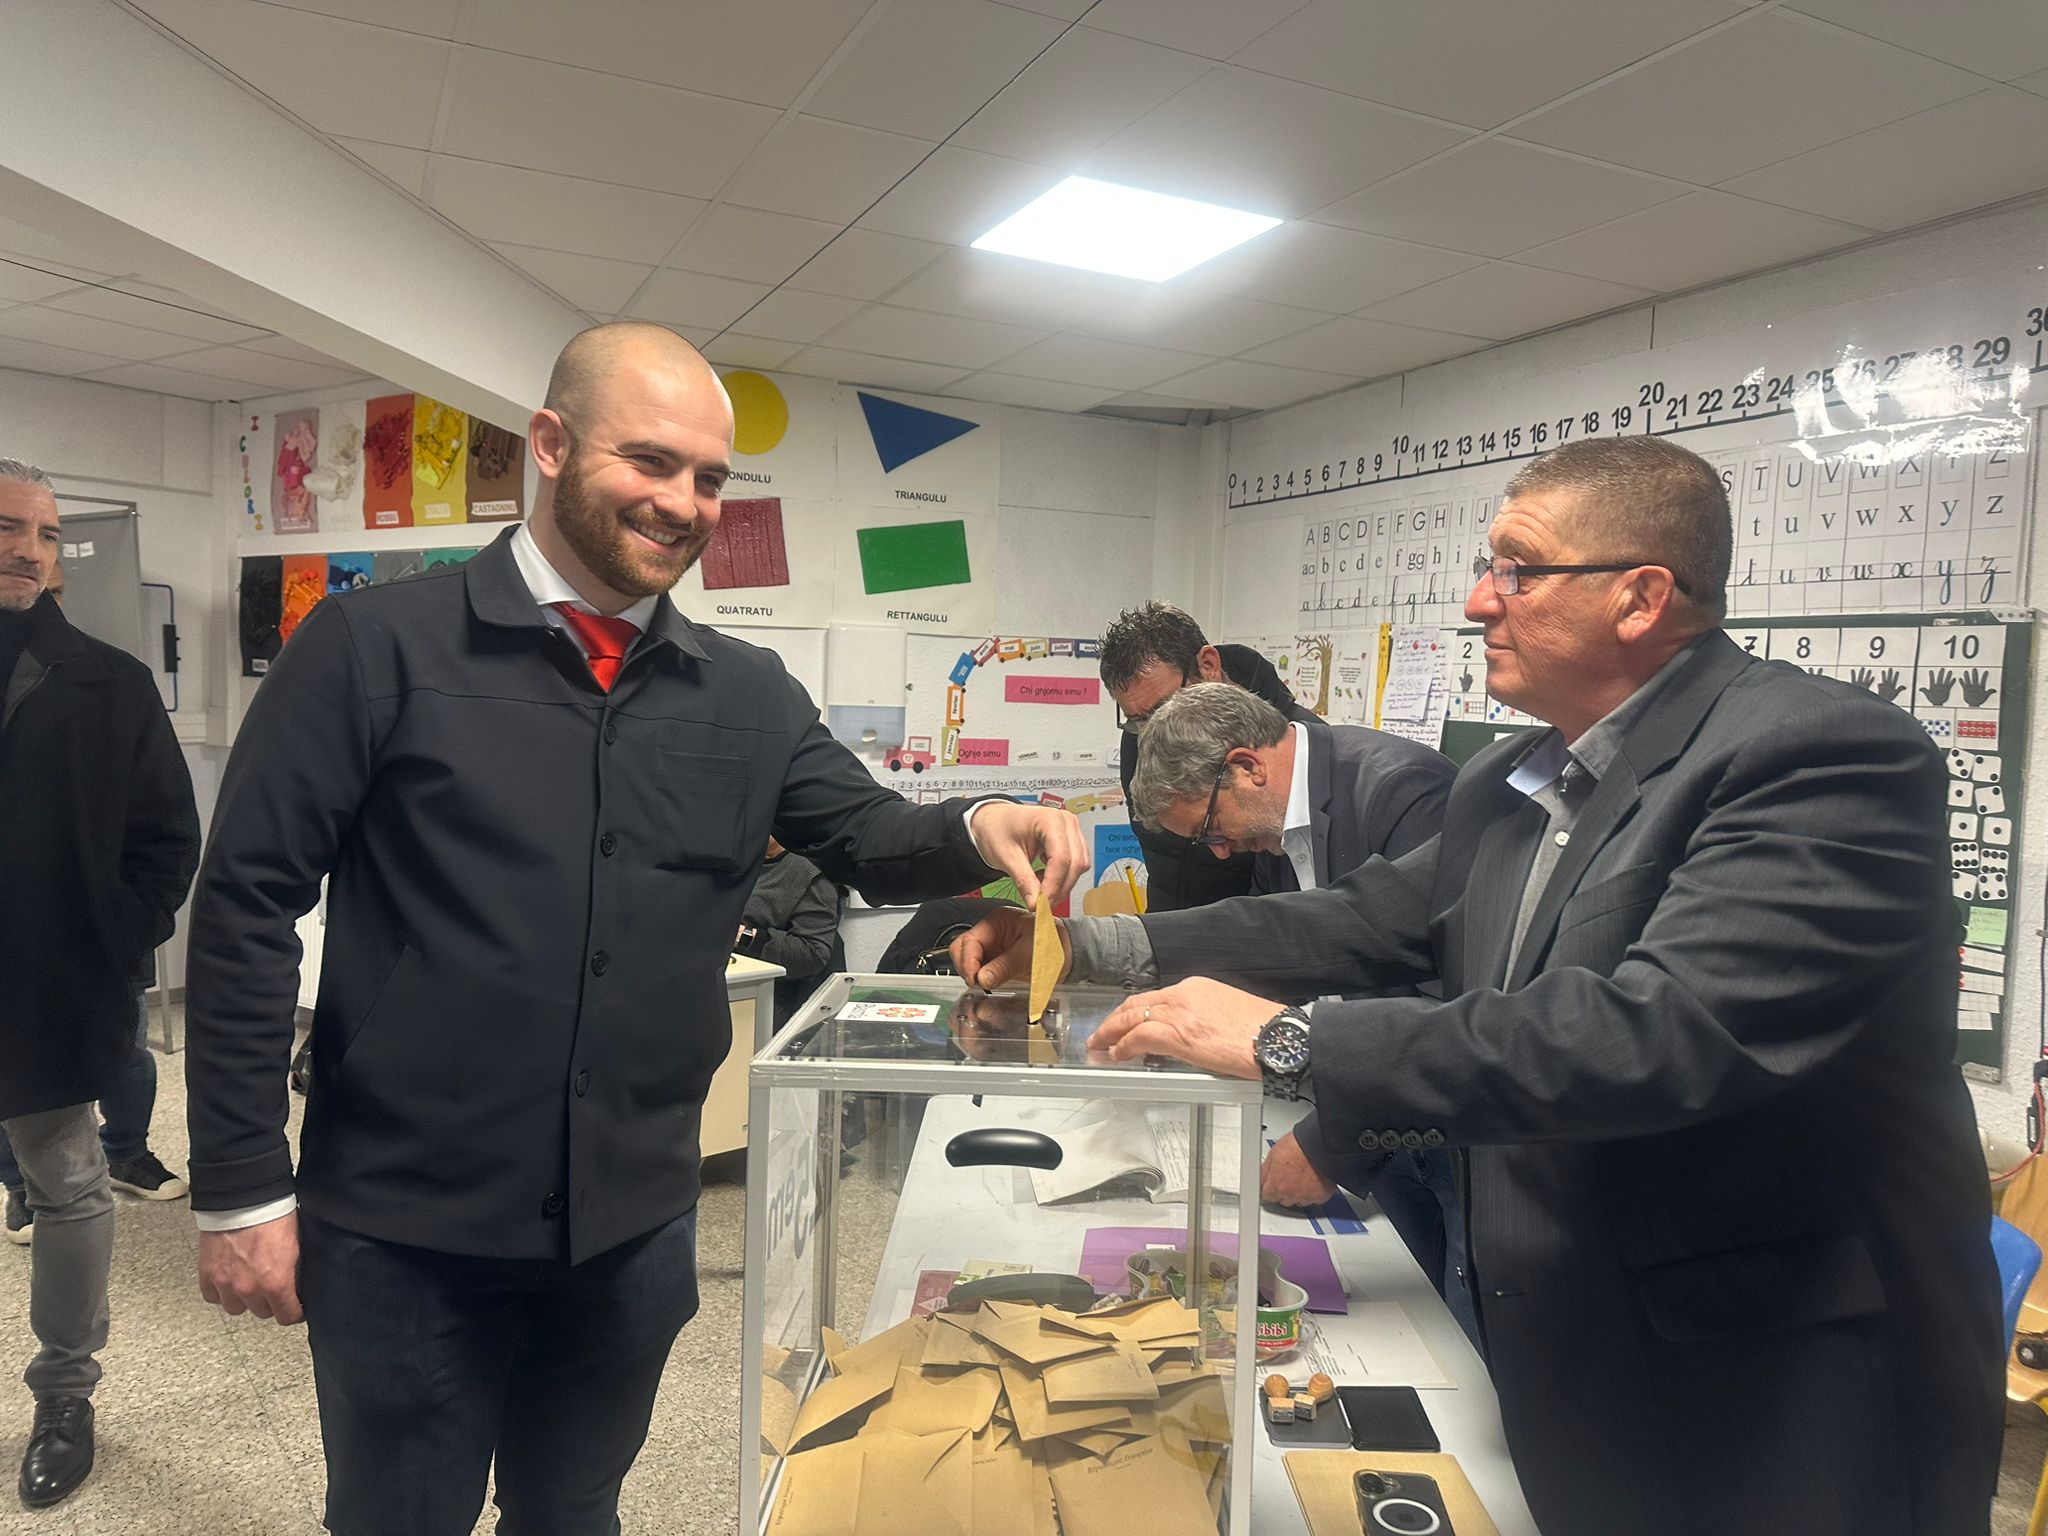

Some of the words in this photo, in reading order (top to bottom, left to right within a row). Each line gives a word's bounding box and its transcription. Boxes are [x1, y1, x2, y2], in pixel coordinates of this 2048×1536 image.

[1228, 474, 1237, 489] 0
[1242, 480, 1247, 494] 1
[1257, 477, 1263, 492] 2
[1273, 474, 1280, 490] 3
[1287, 472, 1294, 487] 4
[1304, 469, 1312, 485] 5
[1322, 465, 1330, 481] 6
[1339, 461, 1347, 478] 7
[1356, 457, 1365, 474] 8
[1374, 454, 1383, 471] 9
[1392, 435, 1409, 455] 10
[1412, 444, 1425, 463] 11
[1432, 440, 1449, 459] 12
[1456, 435, 1473, 456] 13
[1479, 432, 1496, 452] 14
[1503, 427, 1520, 448] 15
[1529, 423, 1547, 444] 16
[1555, 418, 1574, 439] 17
[1581, 412, 1600, 434] 18
[1611, 406, 1631, 429] 19
[1638, 382, 1665, 407] 20
[1666, 394, 1688, 421] 21
[1697, 389, 1723, 415] 22
[1732, 384, 1760, 409] 23
[1766, 375, 1794, 402] 24
[1973, 337, 2011, 368] 29
[727, 472, 771, 484] ONDULU
[895, 490, 947, 503] TRIANGULU
[1305, 529, 1315, 546] A
[1323, 526, 1331, 543] B
[1339, 523, 1350, 541] C
[1357, 521, 1368, 538] D
[1377, 518, 1385, 535] E
[1397, 515, 1405, 533] F
[1413, 512, 1426, 531] G
[1434, 509, 1446, 529] H
[1459, 507, 1464, 526] I
[1478, 503, 1488, 523] J
[1722, 470, 1733, 494] S
[1755, 466, 1768, 491] T
[1787, 462, 1803, 488] U
[1825, 460, 1841, 483] V
[1303, 563, 1315, 576] aa
[1322, 558, 1330, 574] b
[1339, 560, 1347, 572] c
[1356, 553, 1365, 571] d
[1375, 556, 1383, 569] e
[1395, 549, 1403, 567] f
[1407, 553, 1425, 571] gg
[1433, 546, 1442, 564] h
[1455, 545, 1461, 564] i
[1752, 517, 1760, 537] t
[1785, 515, 1799, 534] u
[1821, 512, 1836, 530] v
[1856, 508, 1880, 527] w
[1897, 504, 1915, 523] x
[1940, 499, 1960, 526] y
[1987, 495, 2004, 515] z
[716, 605, 773, 616] QUATRATU
[886, 611, 948, 623] RETTANGULU
[1462, 642, 1472, 659] 2
[1796, 636, 1811, 659] 8
[1869, 636, 1885, 659] 9
[1944, 634, 1980, 659] 10
[1020, 686, 1033, 695] Chi
[1082, 687, 1088, 695] ?
[958, 749, 981, 759] Oghje
[983, 750, 1001, 758] simu
